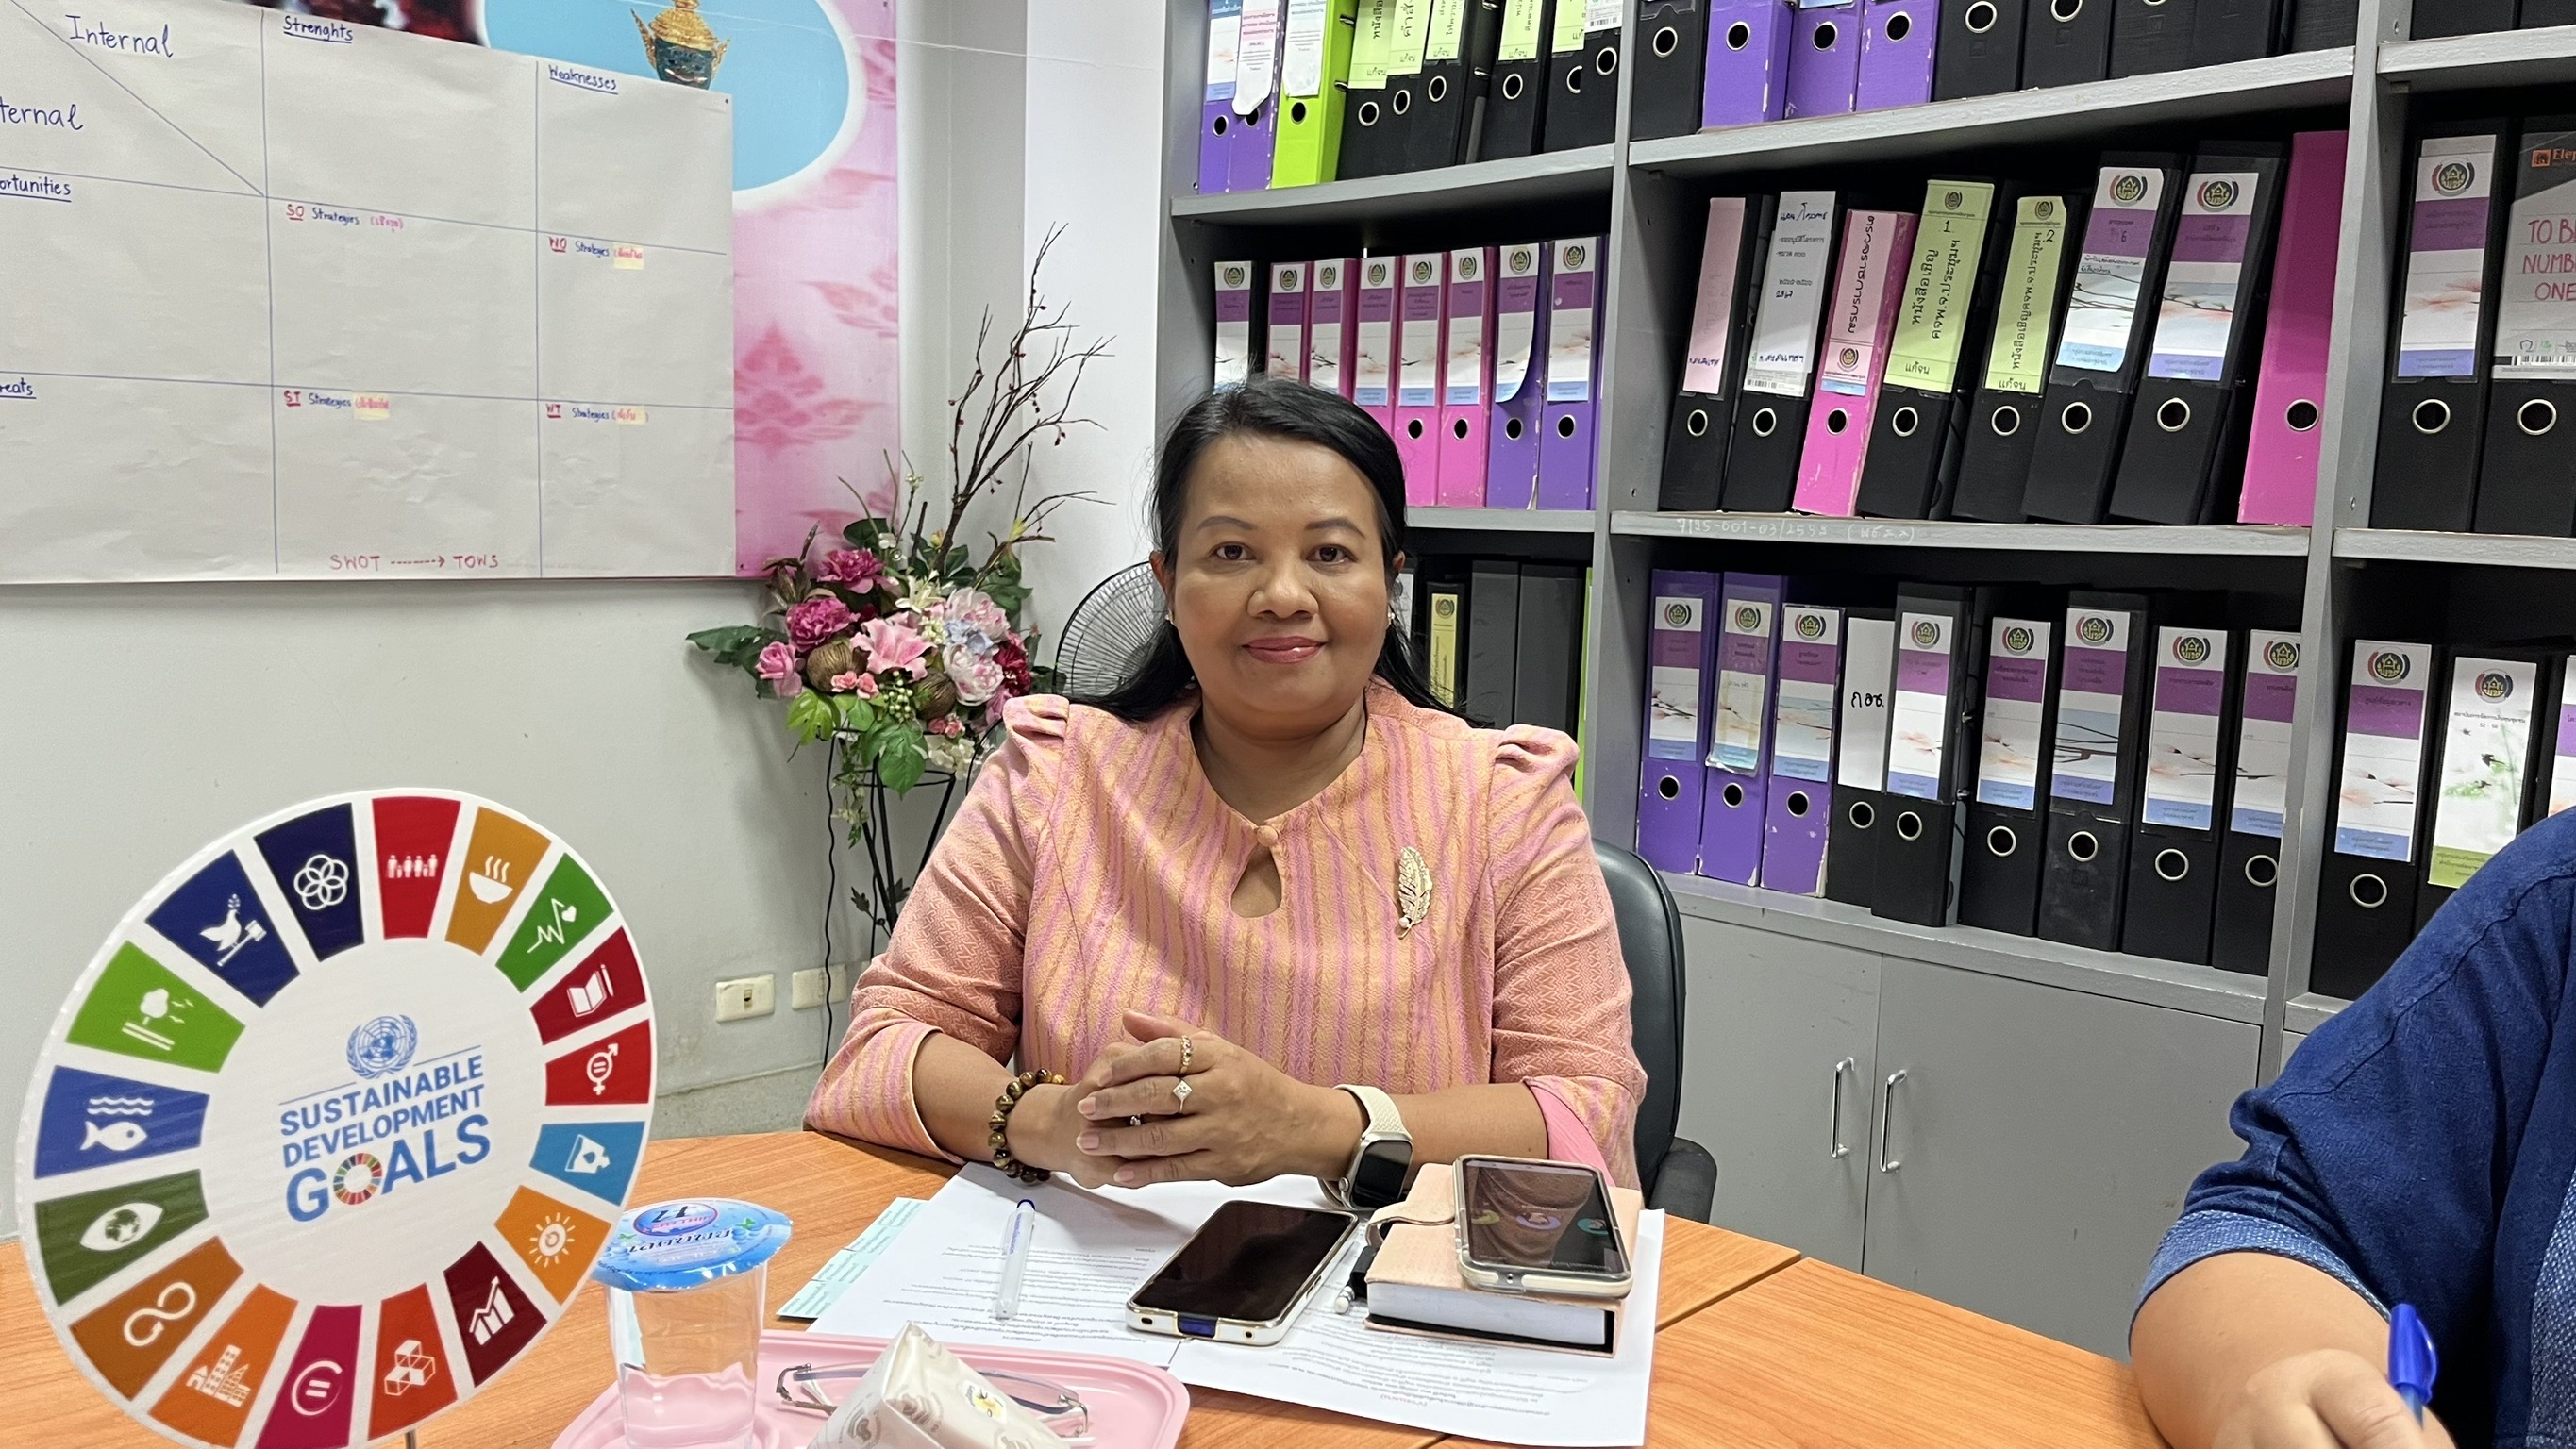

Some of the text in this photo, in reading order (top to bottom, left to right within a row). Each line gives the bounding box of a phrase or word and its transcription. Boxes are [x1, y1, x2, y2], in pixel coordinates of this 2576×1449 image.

[65, 14, 174, 58] Internal
[283, 16, 353, 42] Strenghts
[548, 64, 617, 91] Weaknesses
[0, 99, 84, 130] ternal
[0, 174, 72, 195] ortunities
[286, 204, 305, 219] SO
[312, 207, 360, 226] Strategies
[2528, 219, 2553, 244] TO
[2534, 282, 2576, 301] ONE
[1905, 361, 1931, 375] แก้จน
[1999, 378, 2027, 391] แก้จน
[283, 390, 302, 407] ST
[330, 554, 499, 572] SWOT TOWS
[280, 1055, 484, 1136] SUSTAINABLE
[283, 1083, 485, 1168] DEVELOPMENT
[286, 1114, 491, 1223] GOALS
